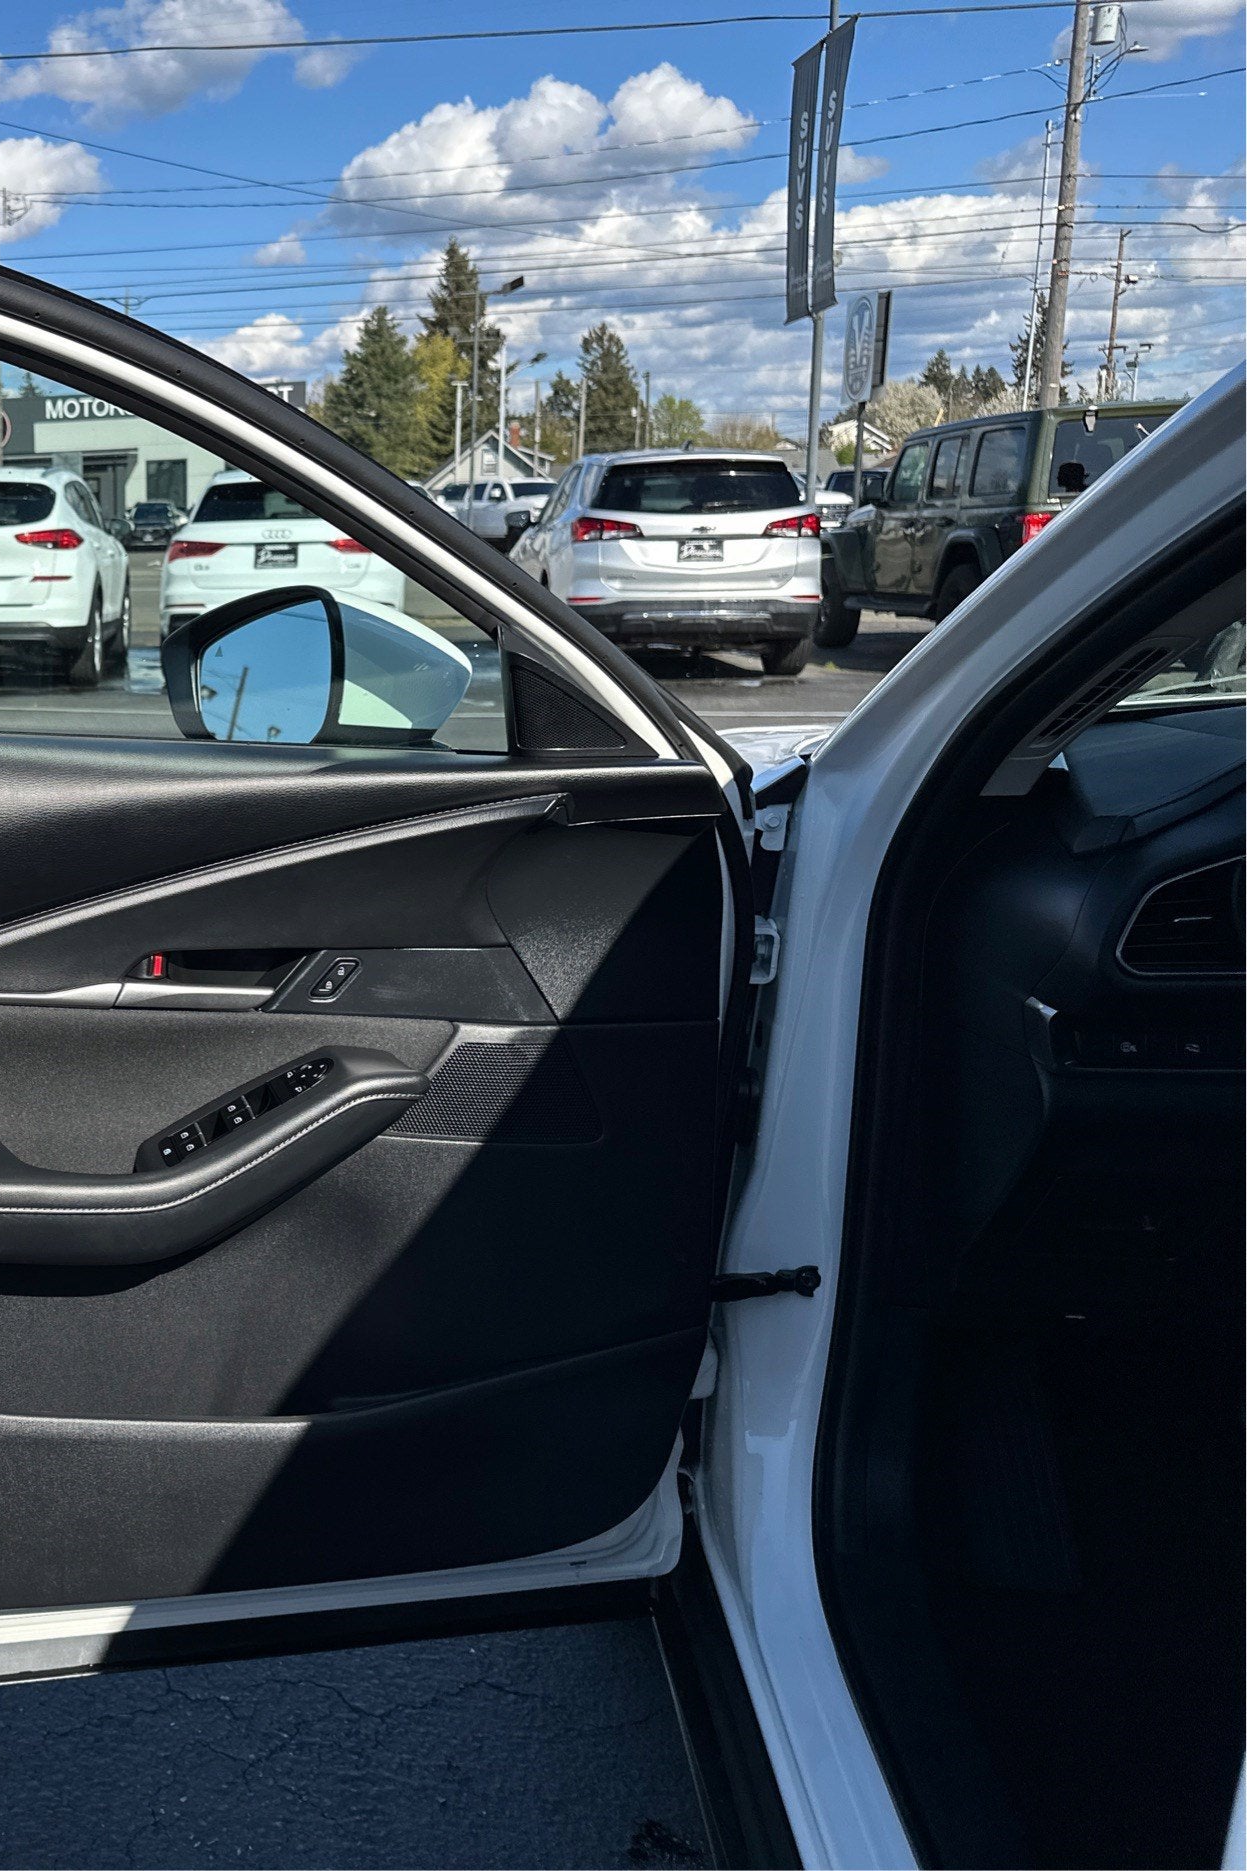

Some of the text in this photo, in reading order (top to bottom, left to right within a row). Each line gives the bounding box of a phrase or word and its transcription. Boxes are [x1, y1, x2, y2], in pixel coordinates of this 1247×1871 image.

[794, 110, 810, 230] SUVS
[821, 90, 837, 215] SUVS
[45, 398, 135, 419] MOTOR
